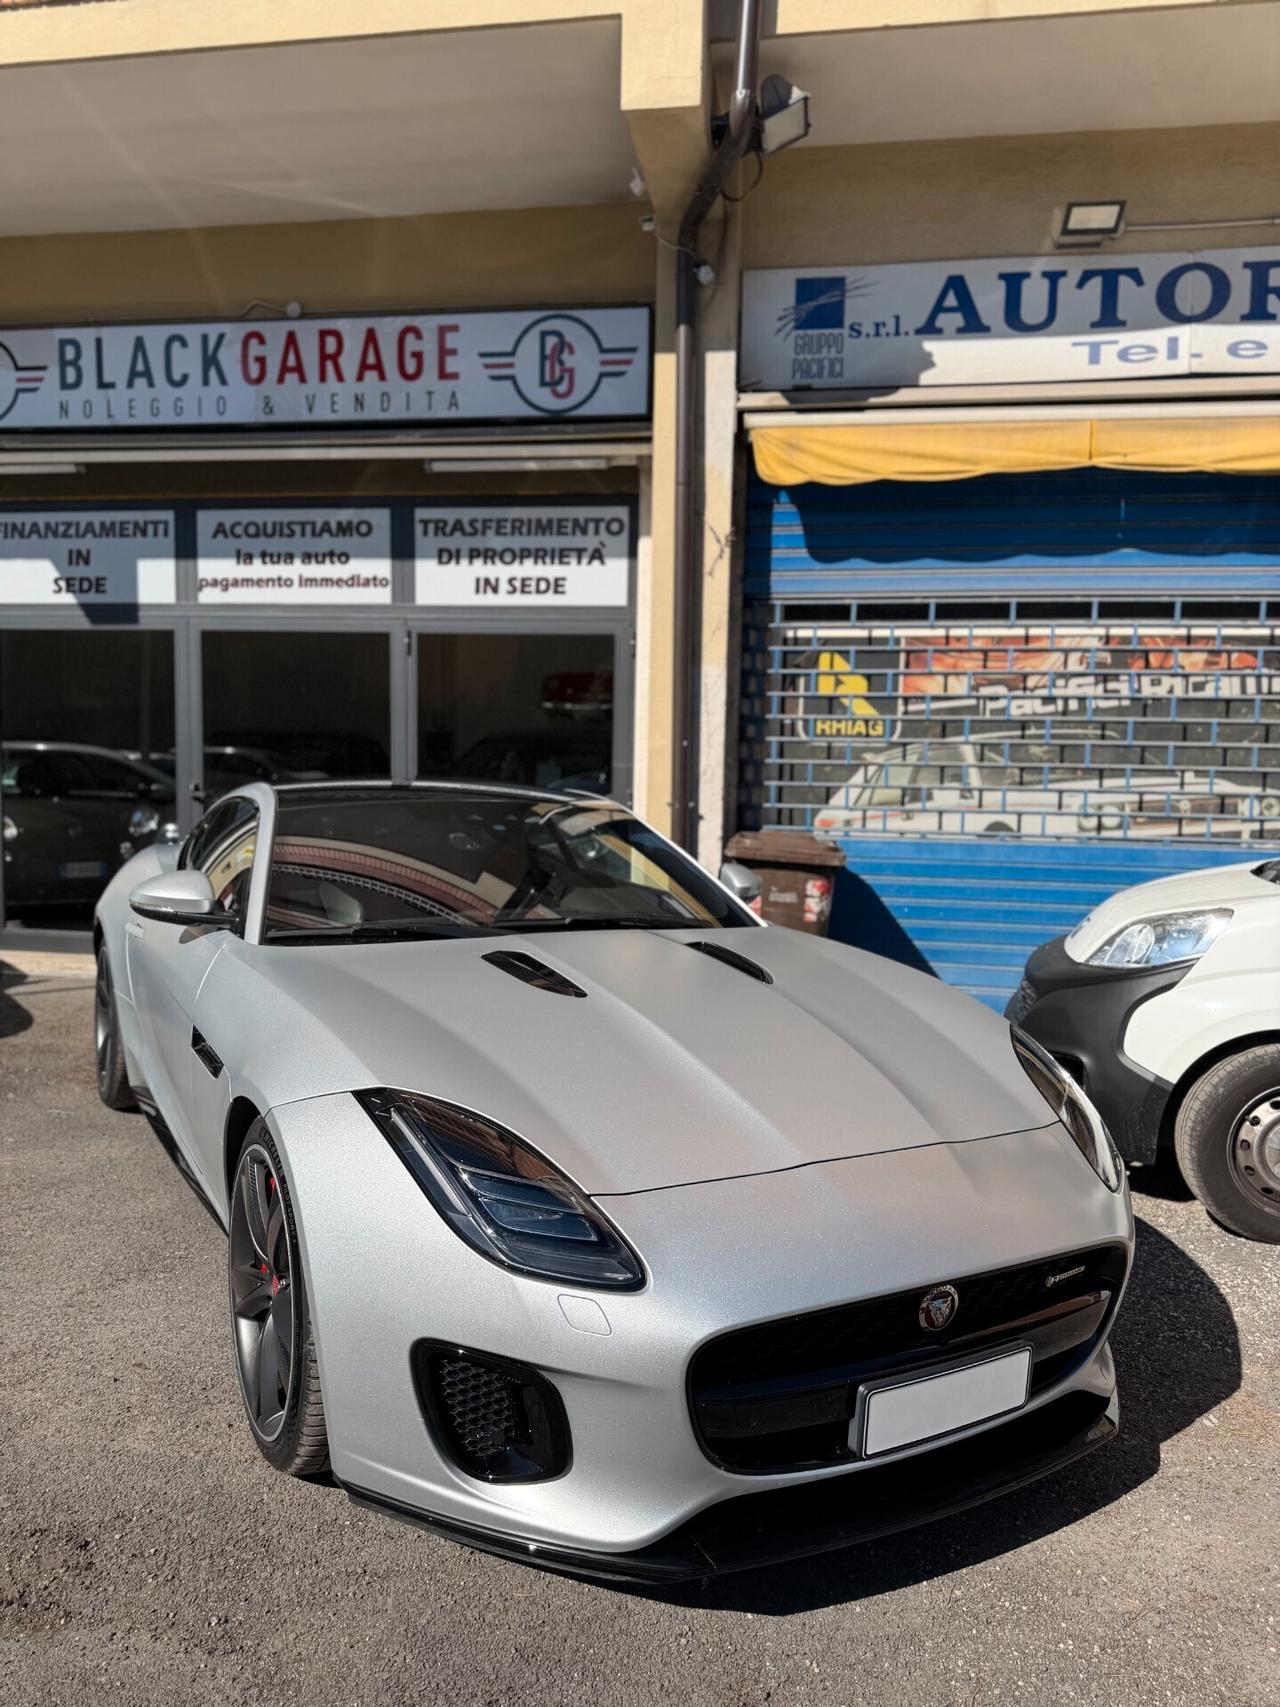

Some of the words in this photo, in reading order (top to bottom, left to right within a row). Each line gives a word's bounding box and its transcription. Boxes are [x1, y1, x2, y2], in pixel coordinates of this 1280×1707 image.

[848, 315, 909, 338] s.r.l.
[794, 332, 844, 356] GRUPPO
[1071, 336, 1203, 366] Tel.
[1226, 340, 1269, 359] e
[792, 357, 844, 380] PACIFICI
[59, 395, 227, 419] NOLEGGIO
[262, 395, 275, 416] &
[304, 390, 461, 414] VENDITA
[0, 520, 169, 540] INANZIAMENTI
[211, 520, 373, 539] ACQUISTIAMO
[419, 517, 625, 537] TRASFERIMENTO
[67, 548, 91, 567] IN
[236, 548, 253, 565] la
[260, 548, 294, 565] tua
[301, 549, 350, 565] auto
[437, 548, 460, 565] DI
[468, 541, 607, 566] PROPRIETÀ
[53, 577, 107, 594] SEDE
[198, 576, 293, 592] pagamento
[299, 574, 390, 588] immediato
[475, 577, 500, 595] IN
[507, 577, 567, 595] SEDE
[816, 719, 884, 737] RHIAG
